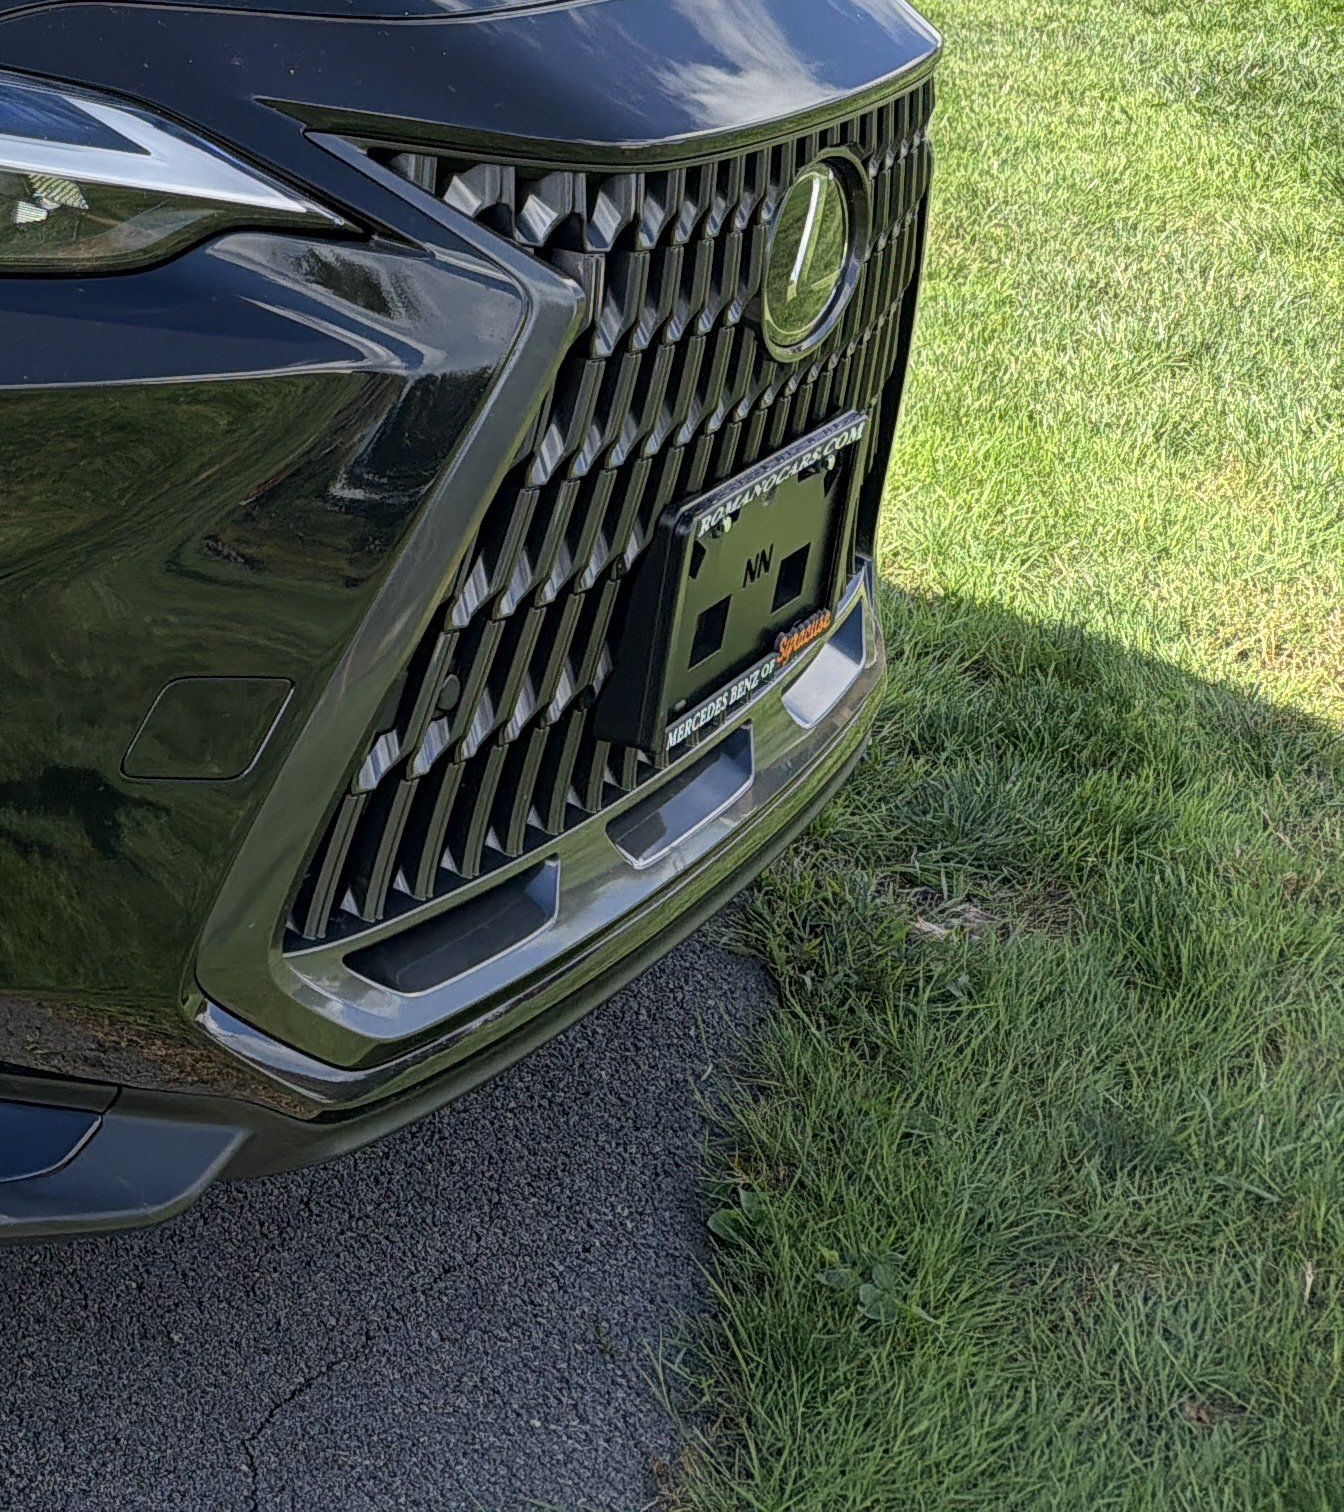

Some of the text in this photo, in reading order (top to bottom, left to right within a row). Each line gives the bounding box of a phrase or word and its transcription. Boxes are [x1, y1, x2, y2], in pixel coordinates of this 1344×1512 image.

[697, 421, 866, 538] ROMANOCARS.COM
[665, 609, 831, 751] MERCEDES BENZ OF Syracuse
